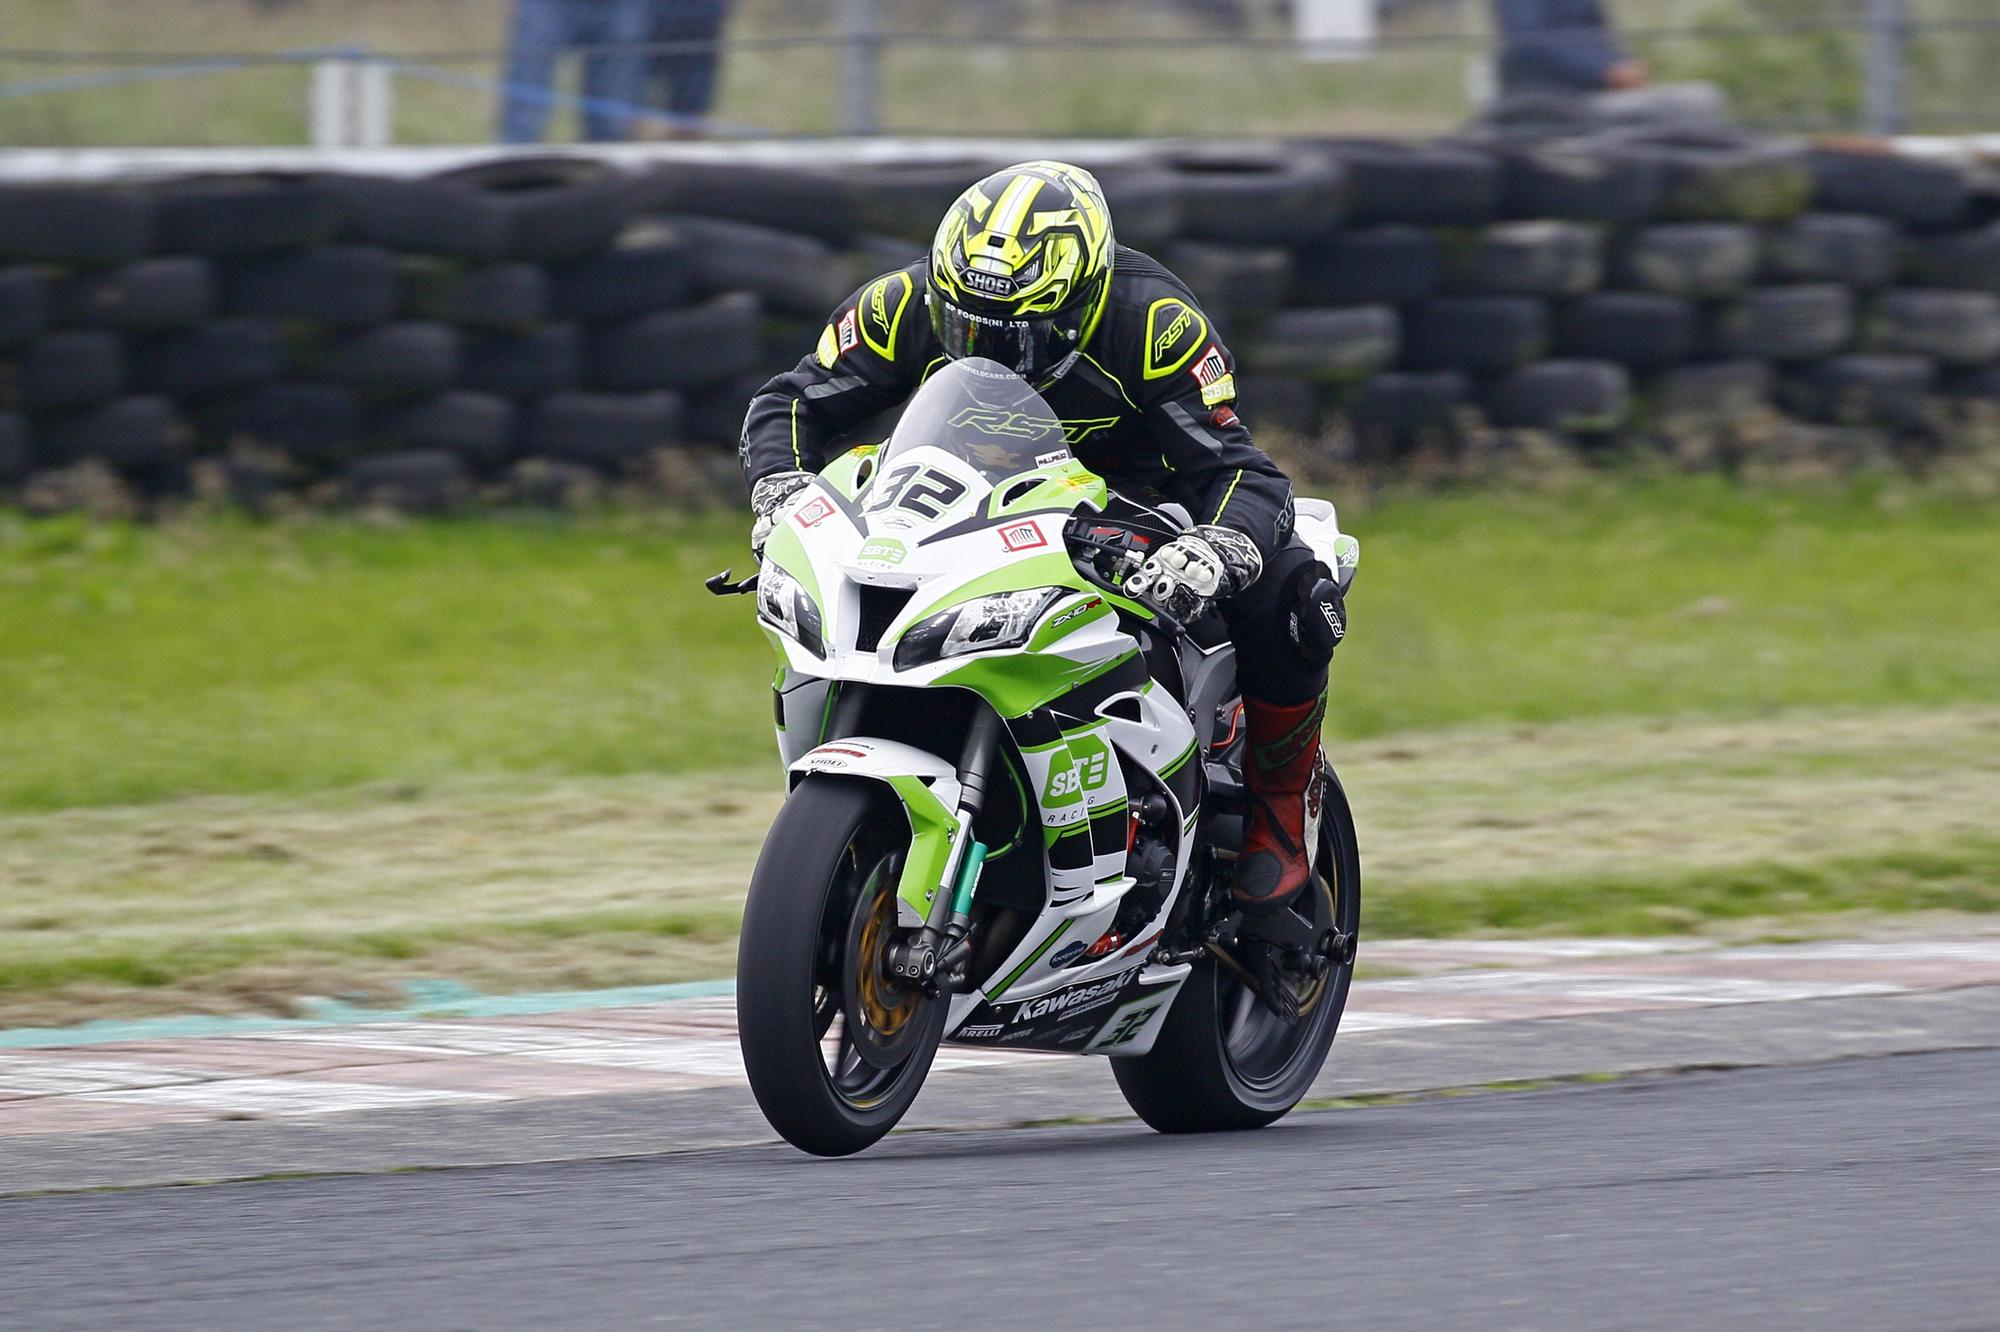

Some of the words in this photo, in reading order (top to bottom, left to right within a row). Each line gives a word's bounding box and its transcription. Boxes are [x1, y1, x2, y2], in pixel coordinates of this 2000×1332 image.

[966, 271, 1012, 295] SHOEI
[1009, 320, 1029, 328] LTD
[1155, 307, 1192, 363] RST
[947, 407, 1121, 444] RST
[866, 465, 967, 519] 32
[1320, 601, 1345, 638] RST
[810, 759, 842, 767] SHOEI
[1046, 795, 1095, 823] RACIG
[1011, 965, 1139, 1024] Kawasaki
[956, 1023, 1005, 1039] PIRELLI
[1095, 1003, 1163, 1048] 32
